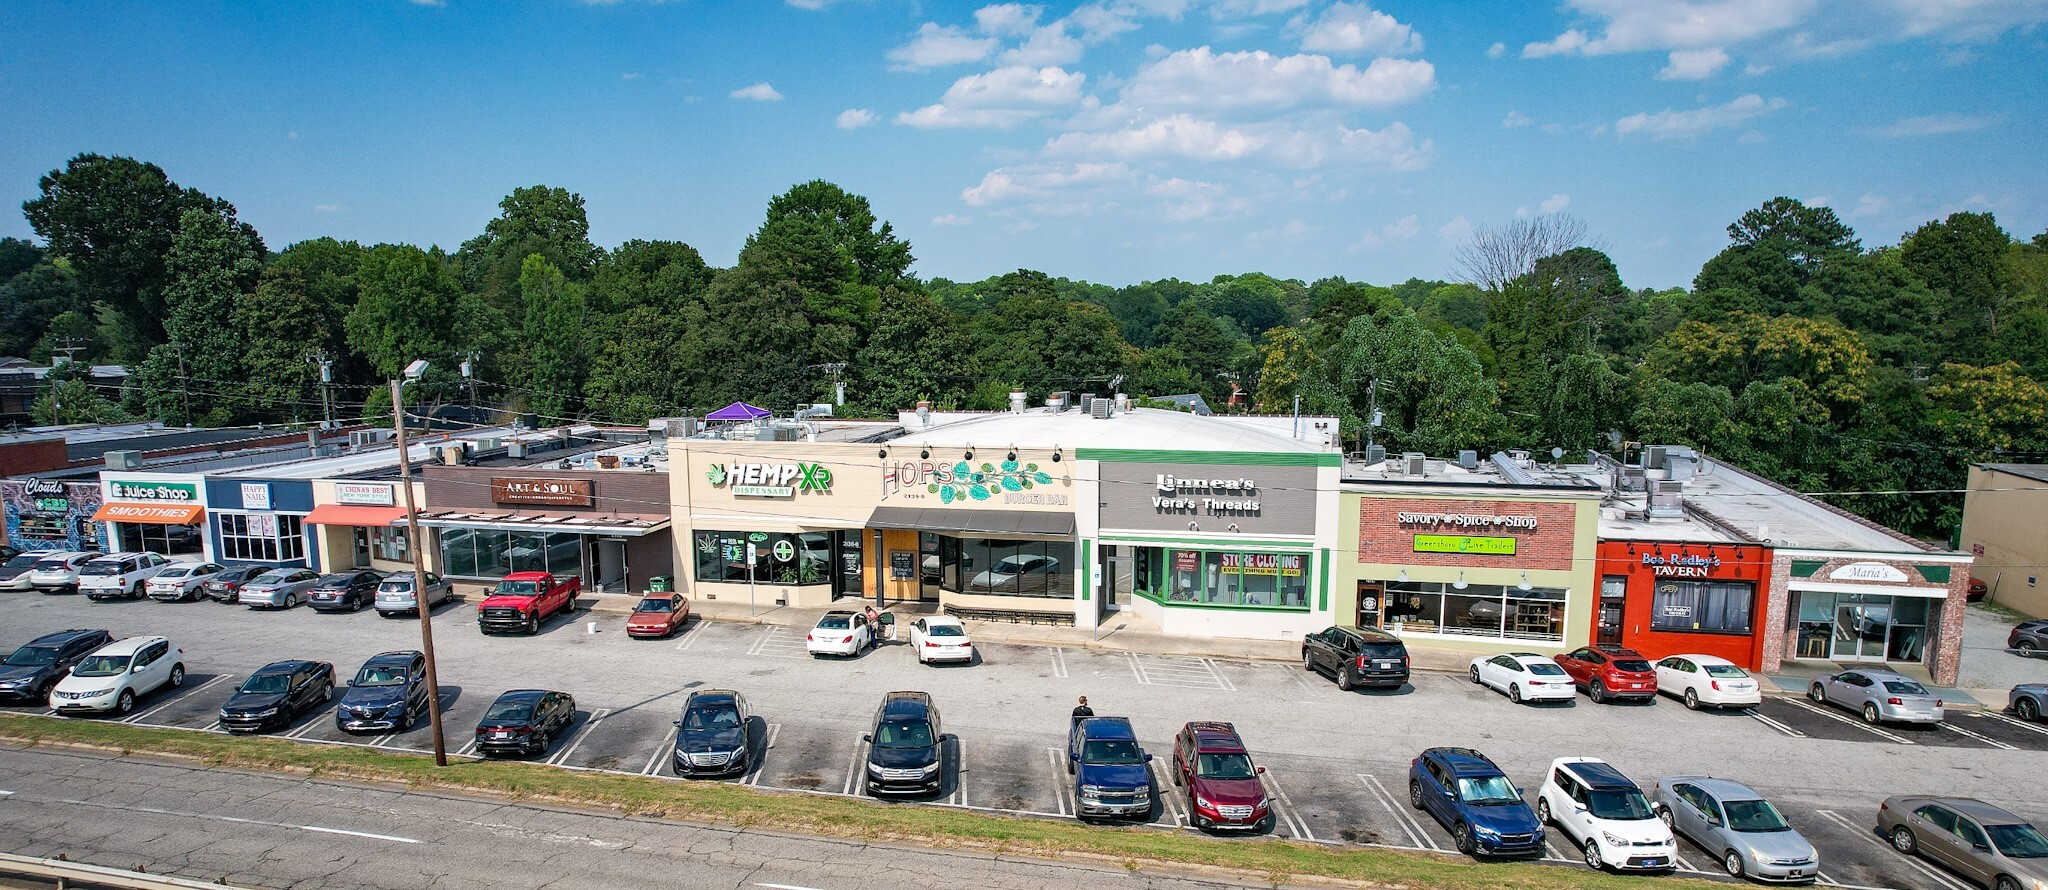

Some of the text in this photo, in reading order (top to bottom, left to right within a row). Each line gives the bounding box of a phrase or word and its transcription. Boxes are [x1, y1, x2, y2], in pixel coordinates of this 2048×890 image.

[880, 459, 955, 501] HOPS
[1156, 474, 1255, 491] Linnea's
[25, 478, 63, 495] Clouds
[124, 485, 188, 500] Juice Shop
[243, 485, 266, 493] HAPPY
[506, 482, 575, 494] ART & SOUL
[734, 487, 791, 495] DISPENSARY
[44, 498, 68, 507] CBD
[1004, 493, 1068, 505] BURGER BAR
[1151, 496, 1260, 510] Vera's Threads
[107, 506, 190, 518] SMOOTHIES
[1398, 511, 1537, 529] Savory Spice Shop
[1416, 538, 1456, 548] Greensboro
[1485, 540, 1514, 549] Traders
[1223, 554, 1254, 566] STORE
[1641, 552, 1720, 568] Boo Radley's
[1652, 566, 1708, 577] TAVERN
[1848, 567, 1889, 578] Maria's
